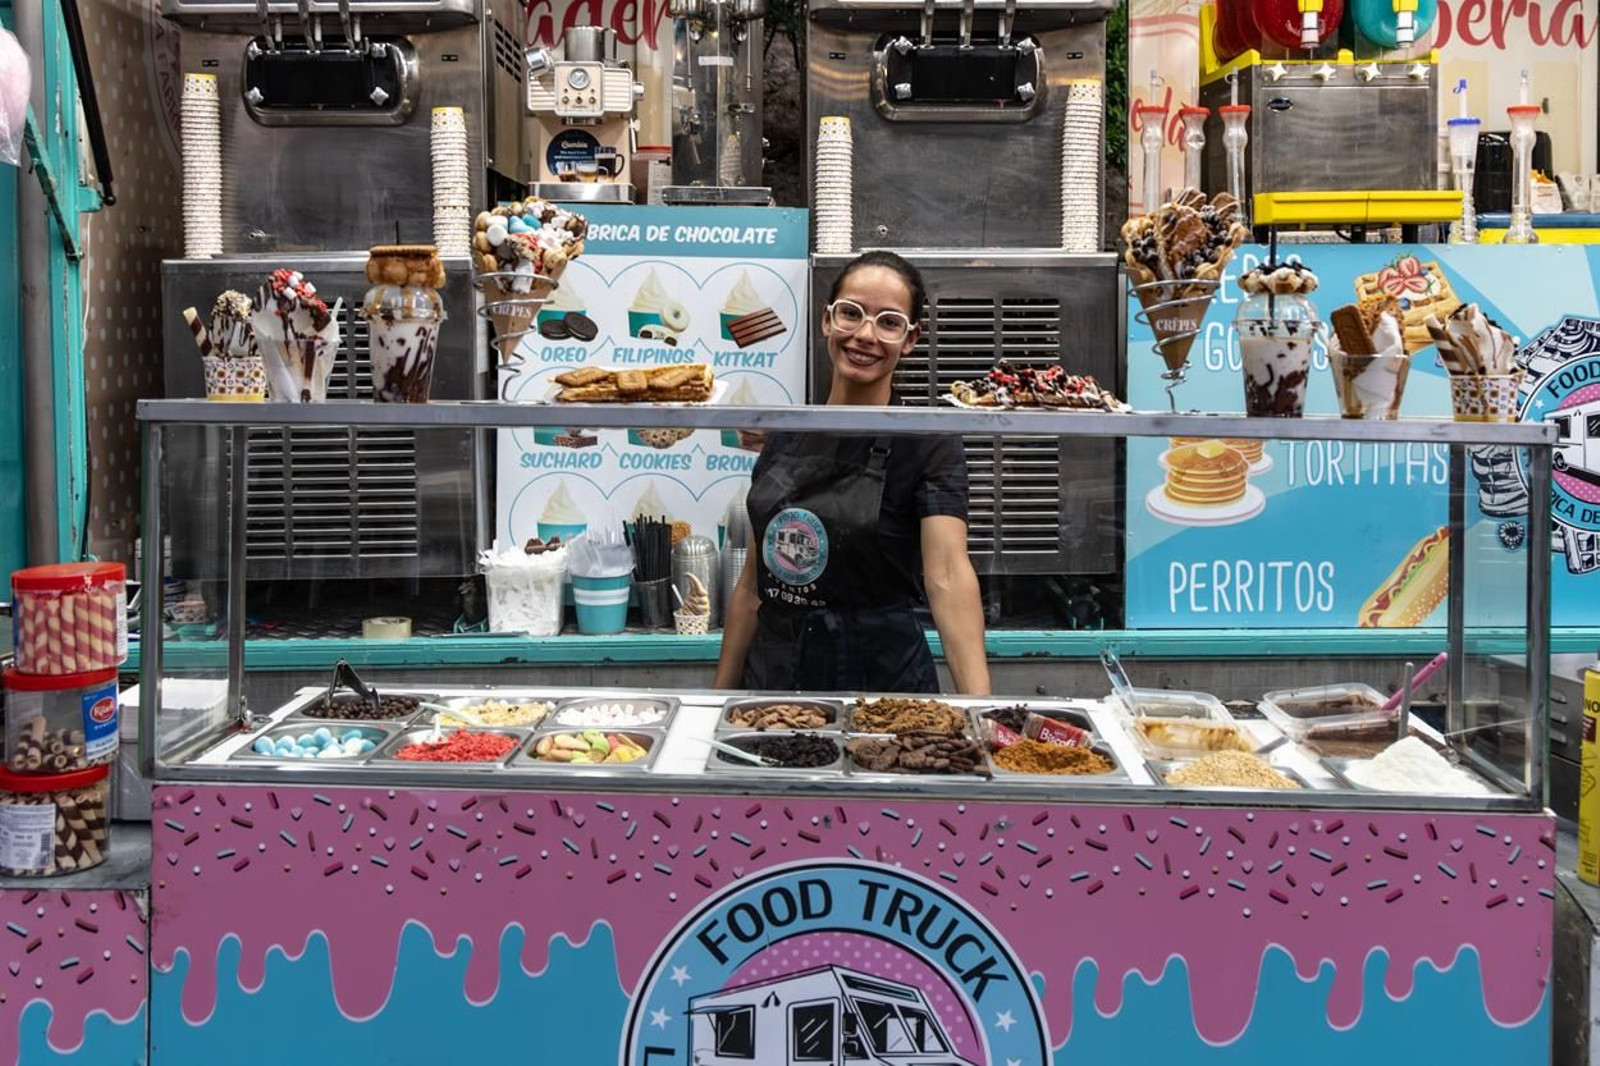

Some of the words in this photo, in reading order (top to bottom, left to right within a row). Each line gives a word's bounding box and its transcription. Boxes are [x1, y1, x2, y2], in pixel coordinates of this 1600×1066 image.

[646, 225, 670, 242] DE
[674, 225, 778, 245] CHOCOLATE
[540, 347, 587, 363] OREO
[612, 348, 695, 364] FILIPINOS
[713, 351, 778, 368] KITKAT
[1546, 361, 1600, 399] FOOD
[520, 452, 603, 469] SUCHARD
[619, 453, 692, 470] COOKIES
[1169, 560, 1335, 613] PERRITOS
[696, 879, 834, 965] FOOD
[858, 879, 1010, 1003] TRUCK
